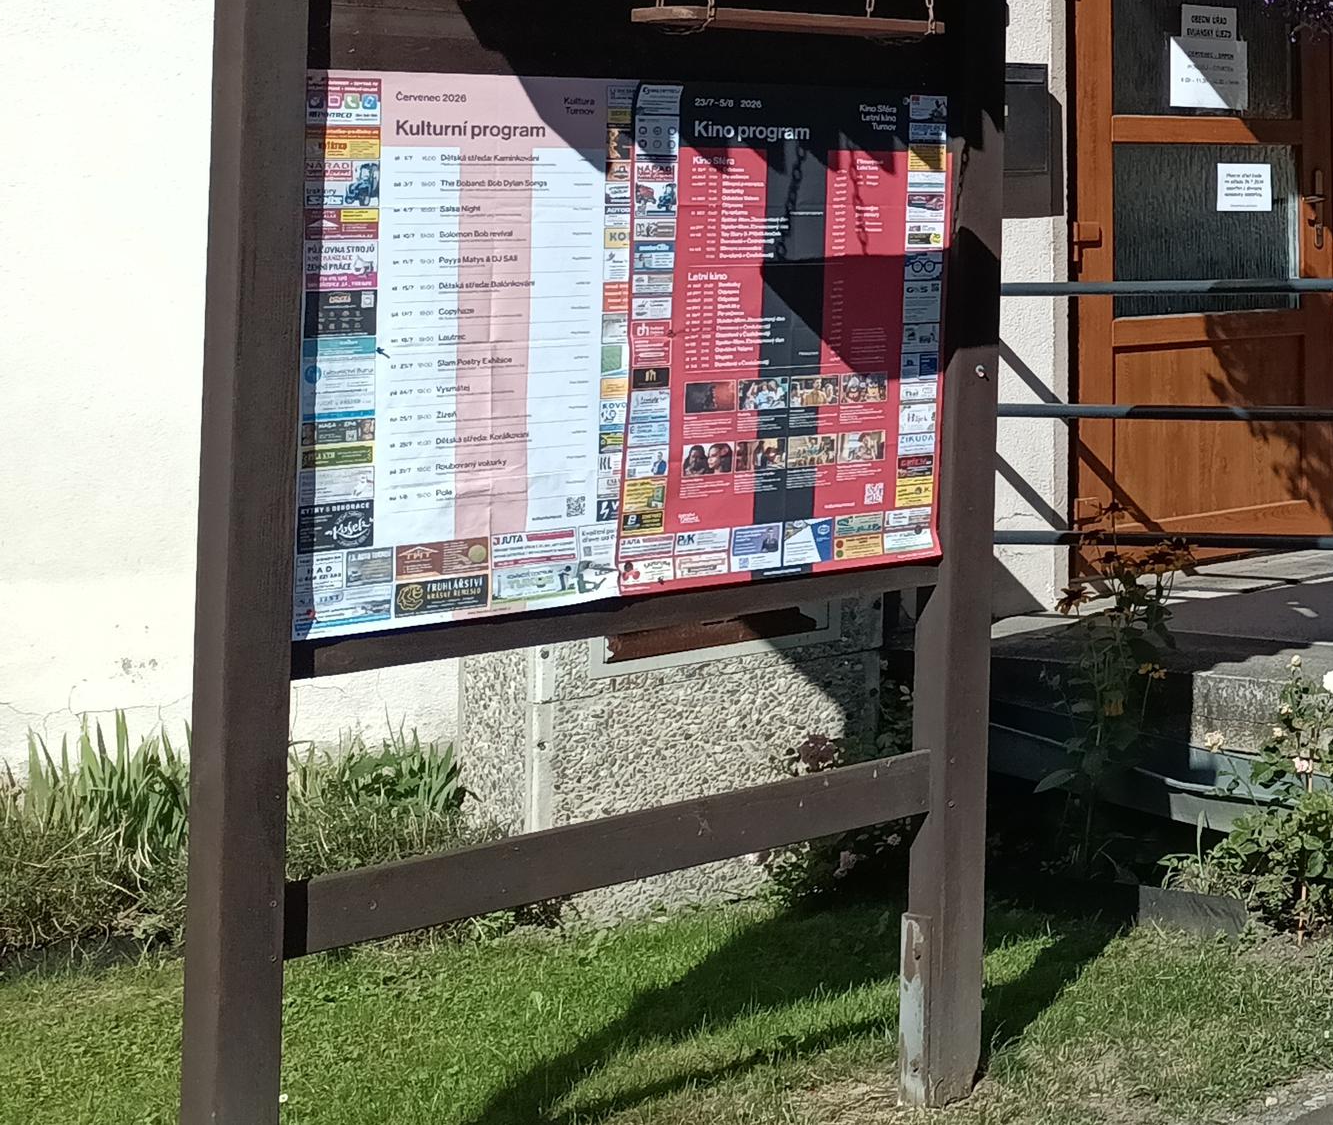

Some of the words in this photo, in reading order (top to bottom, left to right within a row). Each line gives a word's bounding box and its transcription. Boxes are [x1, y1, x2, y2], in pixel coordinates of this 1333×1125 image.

[395, 90, 441, 103] Červenec
[442, 93, 467, 103] 2026
[563, 96, 595, 106] Kultura
[740, 98, 763, 109] 2026
[859, 104, 876, 112] Kino
[565, 106, 595, 115] Turnov
[881, 114, 896, 122] kino
[395, 119, 467, 137] Kulturní
[470, 124, 546, 140] program
[872, 122, 897, 130] Turnov
[694, 120, 735, 138] Kino
[737, 124, 810, 143] program
[692, 155, 711, 165] Kino
[503, 179, 524, 188] Dylan
[524, 179, 547, 188] Songs
[439, 205, 460, 213] Salsa
[461, 206, 481, 214] Night
[687, 272, 708, 281] Letní
[709, 272, 728, 280] kino
[501, 534, 523, 545] JUTA
